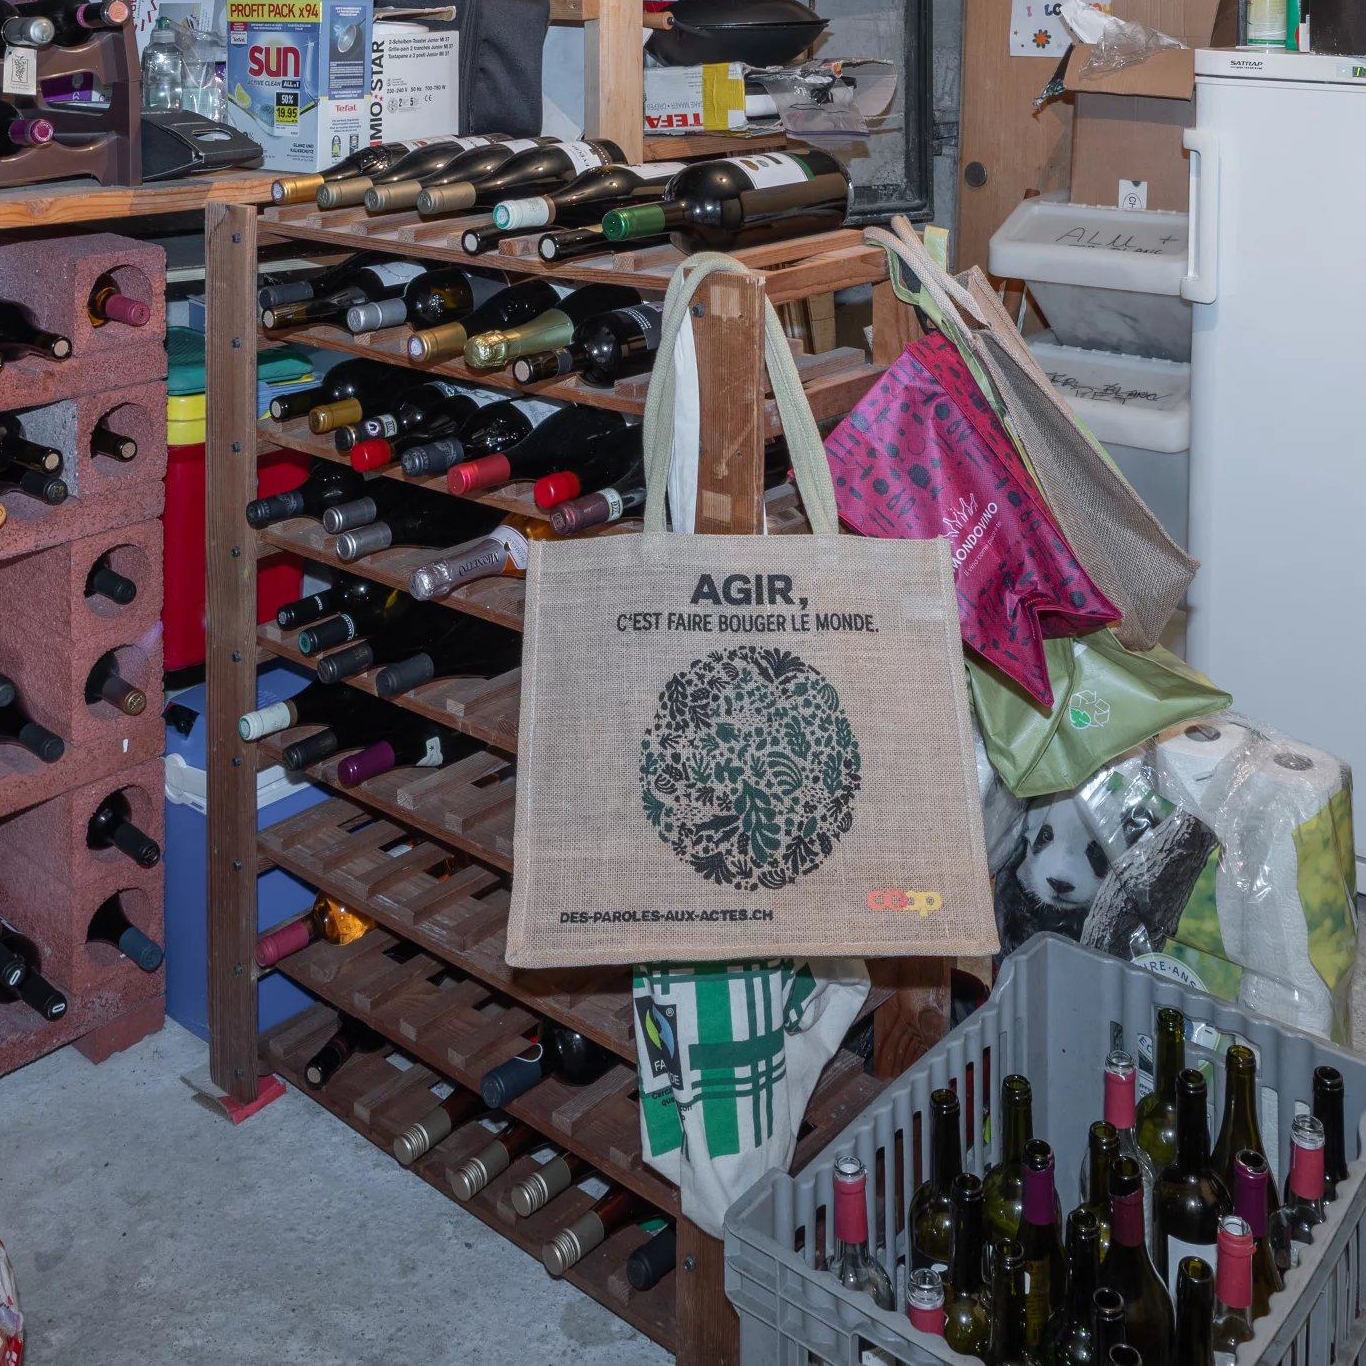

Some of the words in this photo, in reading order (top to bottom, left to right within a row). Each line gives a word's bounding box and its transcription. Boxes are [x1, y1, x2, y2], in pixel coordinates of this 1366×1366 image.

[230, 4, 267, 18] PROFIT
[268, 4, 296, 19] PACK
[299, 7, 319, 19] x94
[276, 107, 298, 118] 19.95
[690, 573, 809, 610] AGIR,
[616, 613, 663, 632] C'EST
[667, 613, 713, 632] FAIRE
[718, 614, 786, 633] BOUGER
[791, 613, 810, 632] LE
[816, 613, 880, 633] MONDE.
[865, 889, 943, 918] coop
[559, 908, 774, 925] DES-PAROLES-AUX-ACTES.CH
